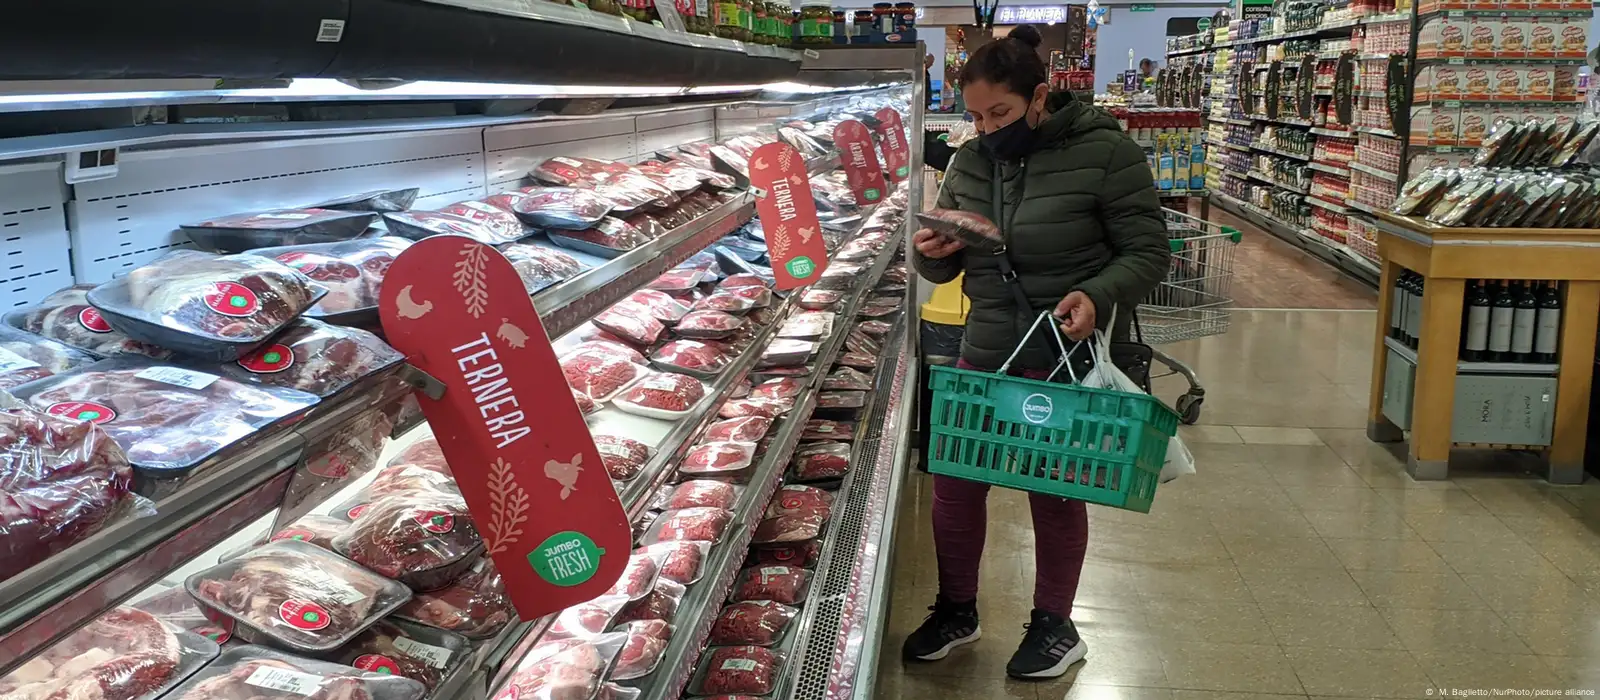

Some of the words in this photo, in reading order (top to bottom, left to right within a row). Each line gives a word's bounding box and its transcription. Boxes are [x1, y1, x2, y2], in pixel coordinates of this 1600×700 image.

[772, 177, 797, 221] TERNERA
[792, 264, 811, 275] FRESH
[451, 332, 531, 449] TERNERA
[1025, 404, 1051, 412] JUMBO
[1481, 399, 1491, 423] MORA
[544, 539, 581, 557] JUMBO
[548, 548, 592, 580] FRESH
